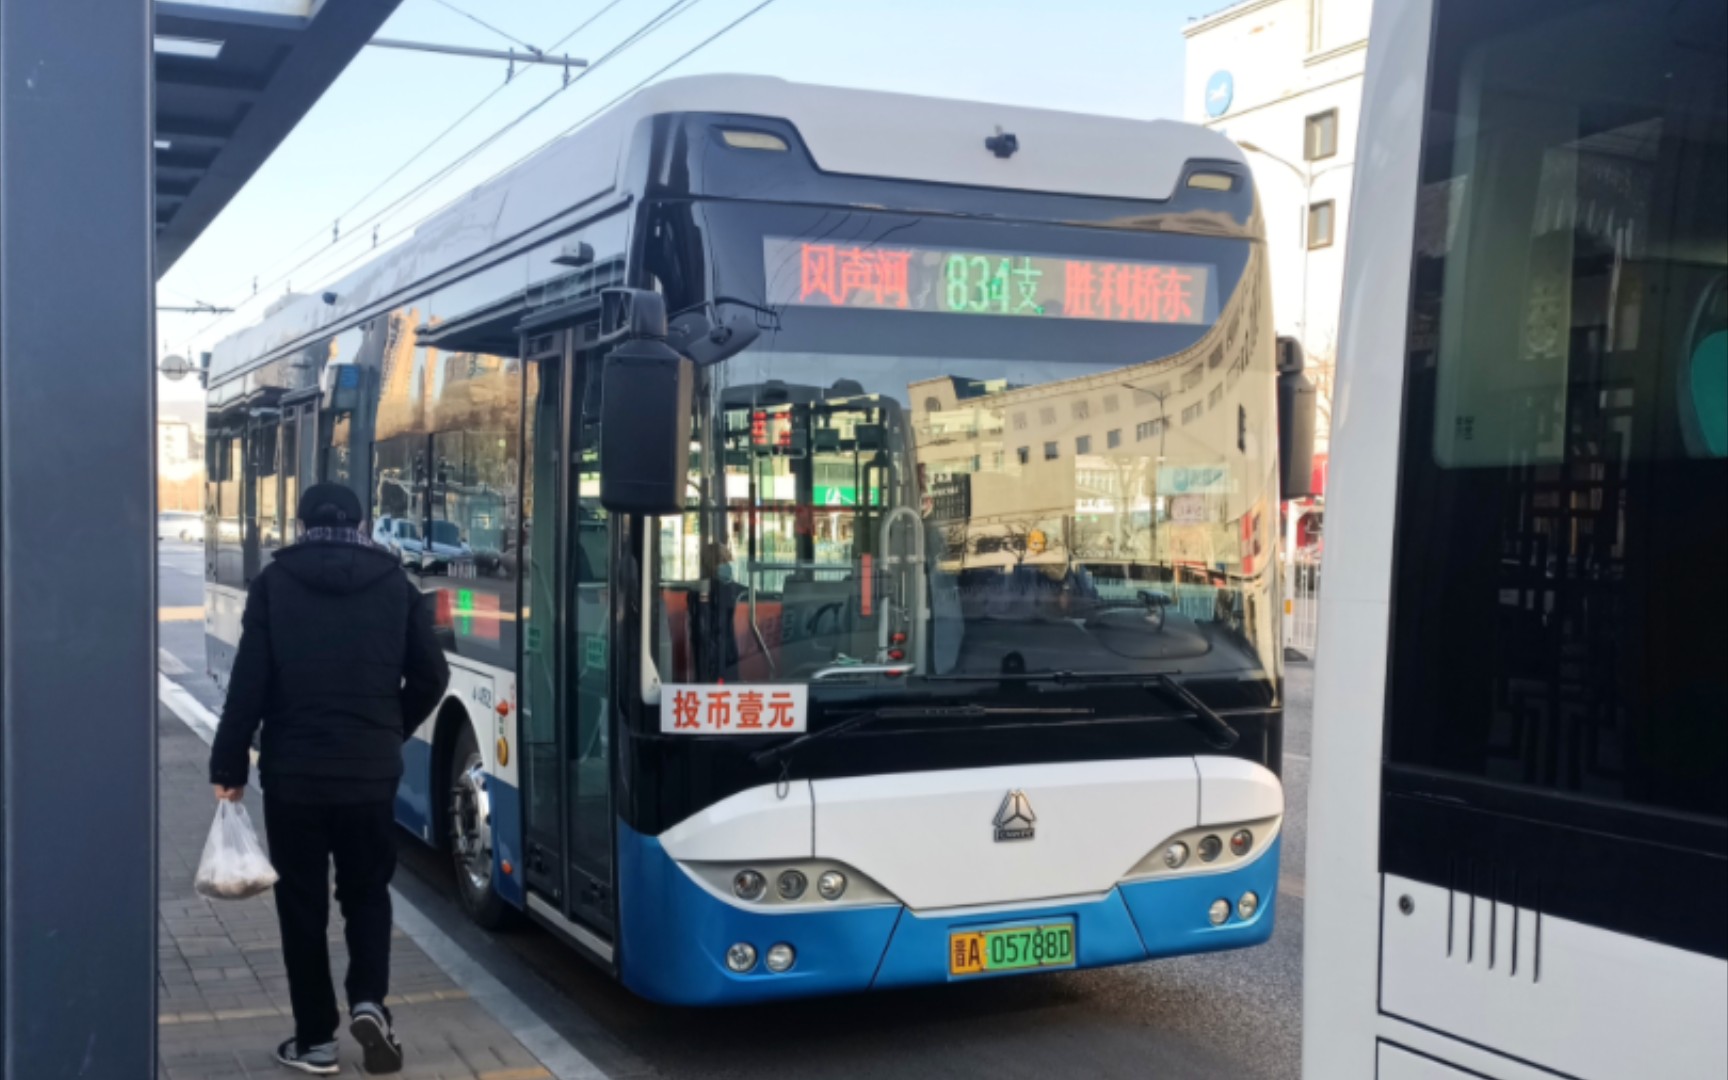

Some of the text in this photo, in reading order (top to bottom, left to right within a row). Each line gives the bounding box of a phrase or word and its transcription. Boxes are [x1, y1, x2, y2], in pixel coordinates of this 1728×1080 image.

[800, 243, 911, 308] 风声河
[1063, 259, 1192, 323] 胜利桥东
[672, 690, 795, 729] 投币壹元
